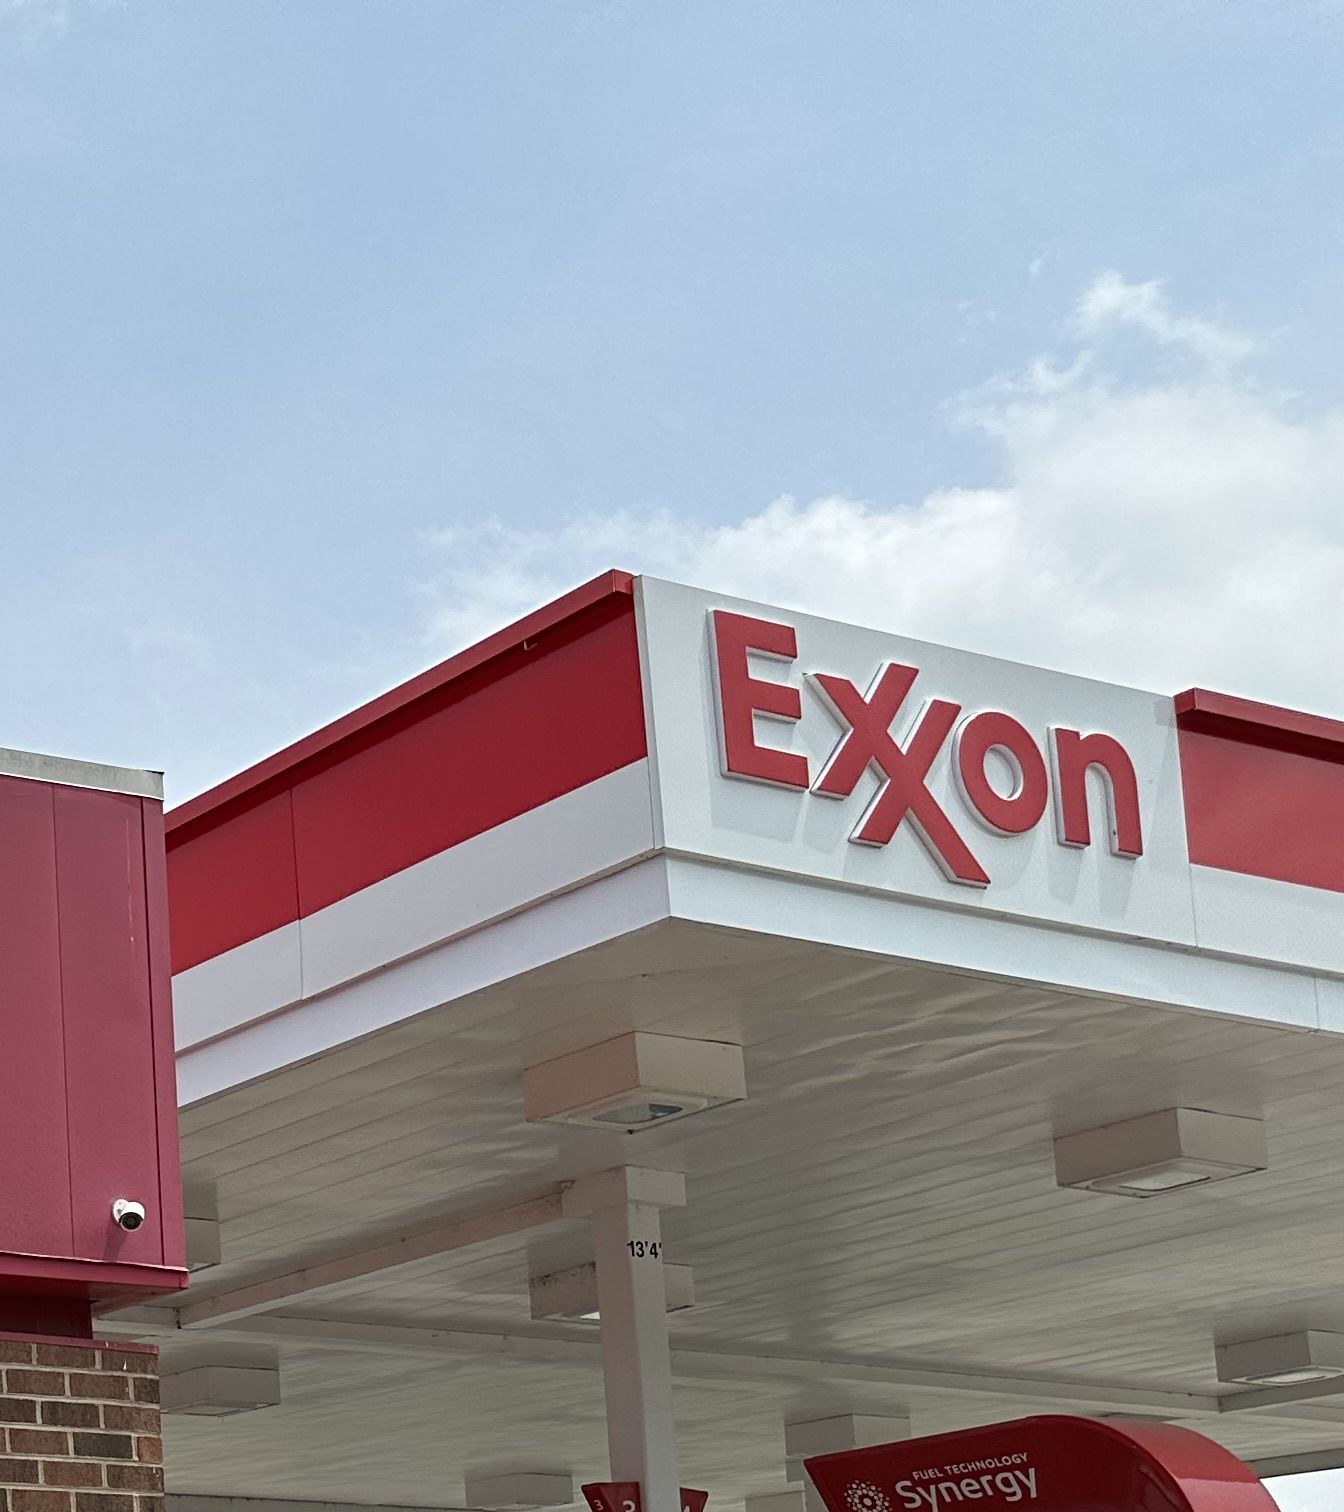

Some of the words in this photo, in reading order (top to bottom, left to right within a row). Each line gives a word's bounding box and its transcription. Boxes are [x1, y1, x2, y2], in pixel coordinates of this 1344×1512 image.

[708, 608, 1144, 889] Exxon
[912, 1467, 944, 1481] FUEL
[944, 1451, 1029, 1476] TECHNOLOGY
[593, 1499, 604, 1511] 3
